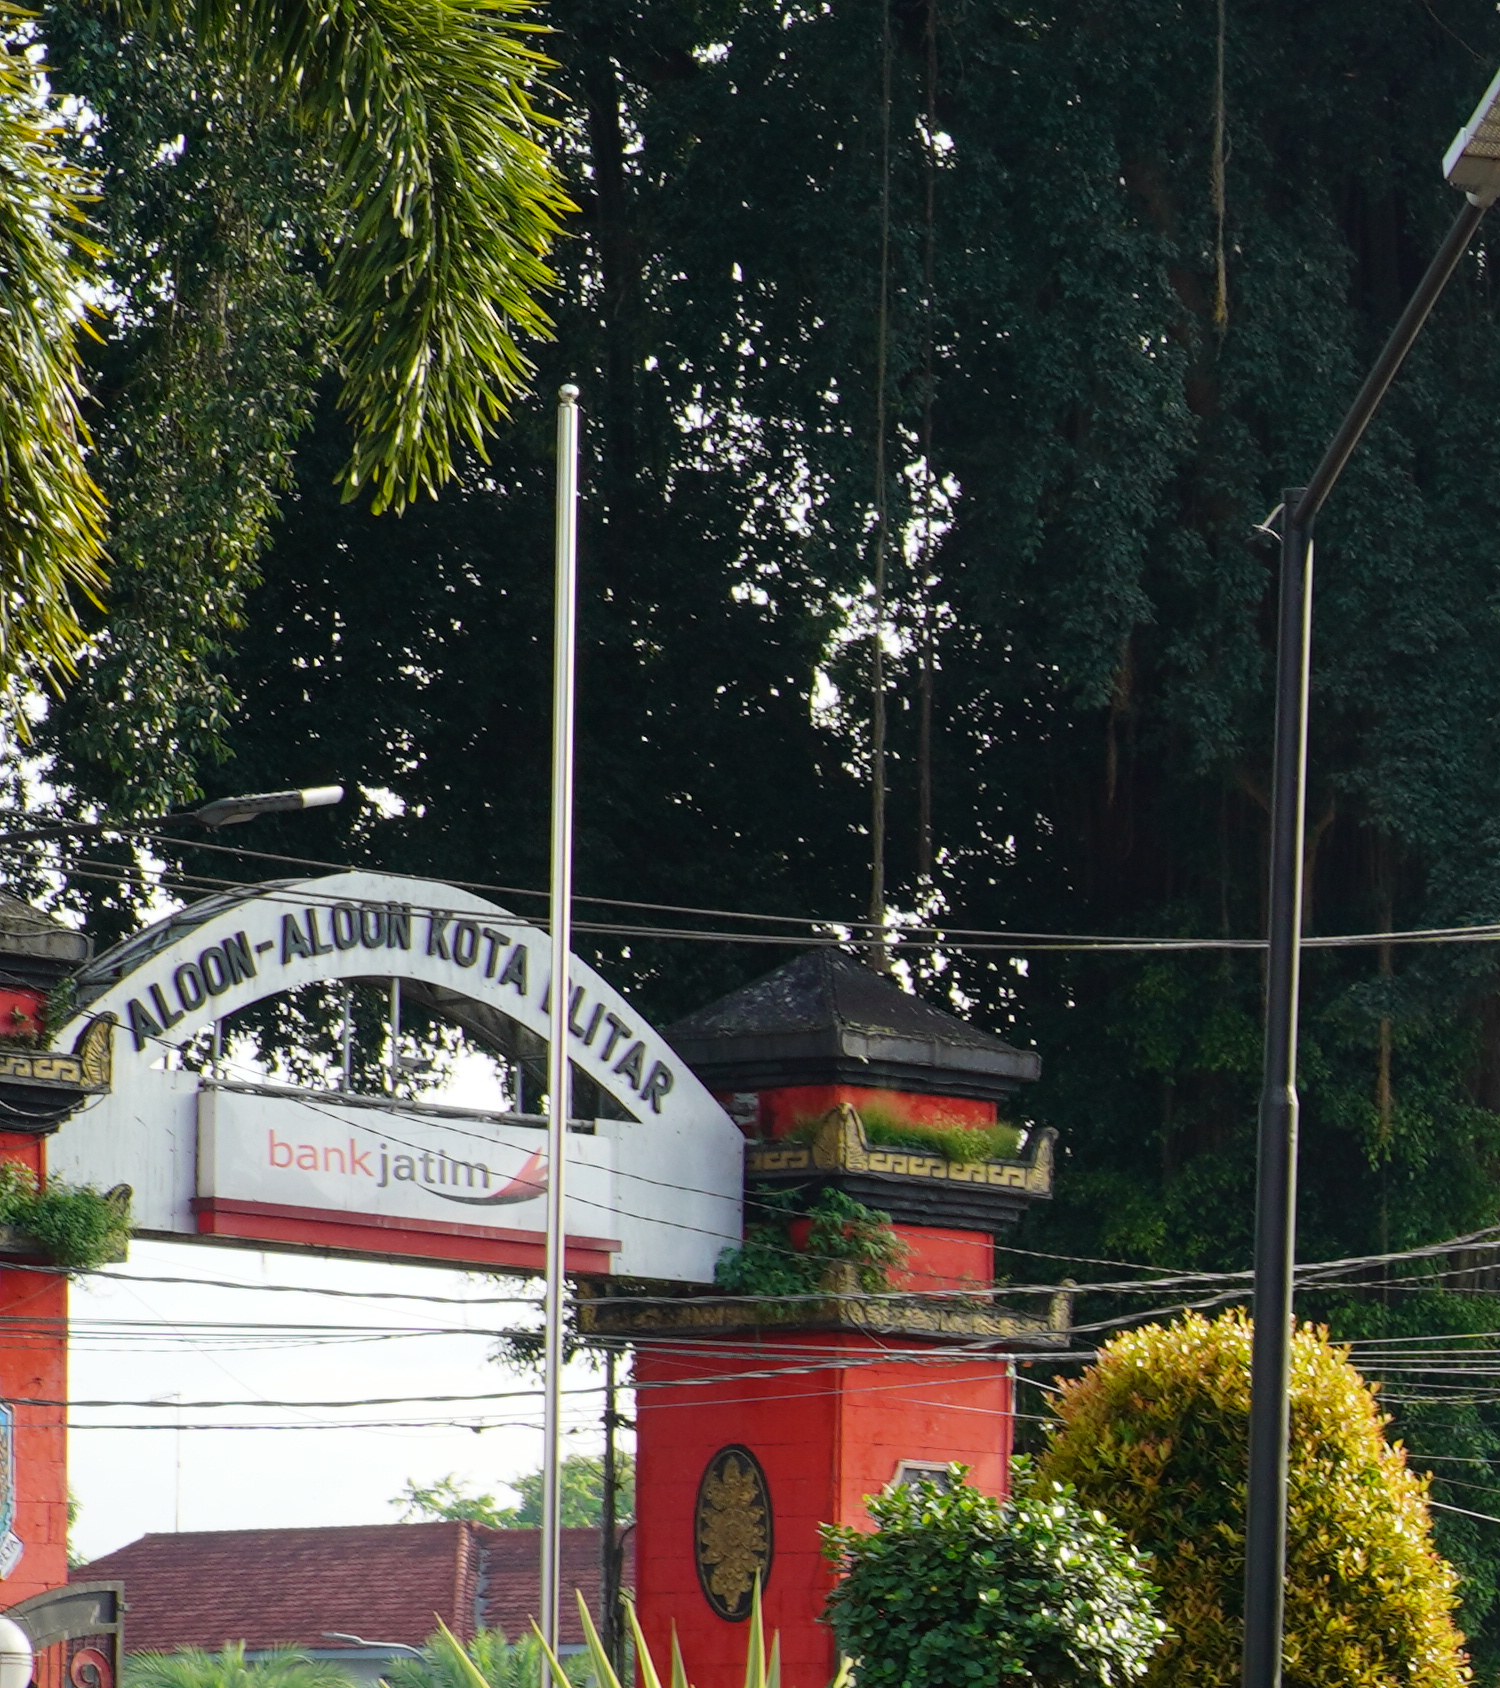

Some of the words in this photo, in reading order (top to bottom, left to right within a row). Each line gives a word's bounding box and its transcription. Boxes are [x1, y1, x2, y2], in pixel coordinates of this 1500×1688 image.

[125, 900, 413, 1052] ALOON-ALOON
[427, 909, 529, 996] KOTA
[542, 971, 675, 1115] LITAR
